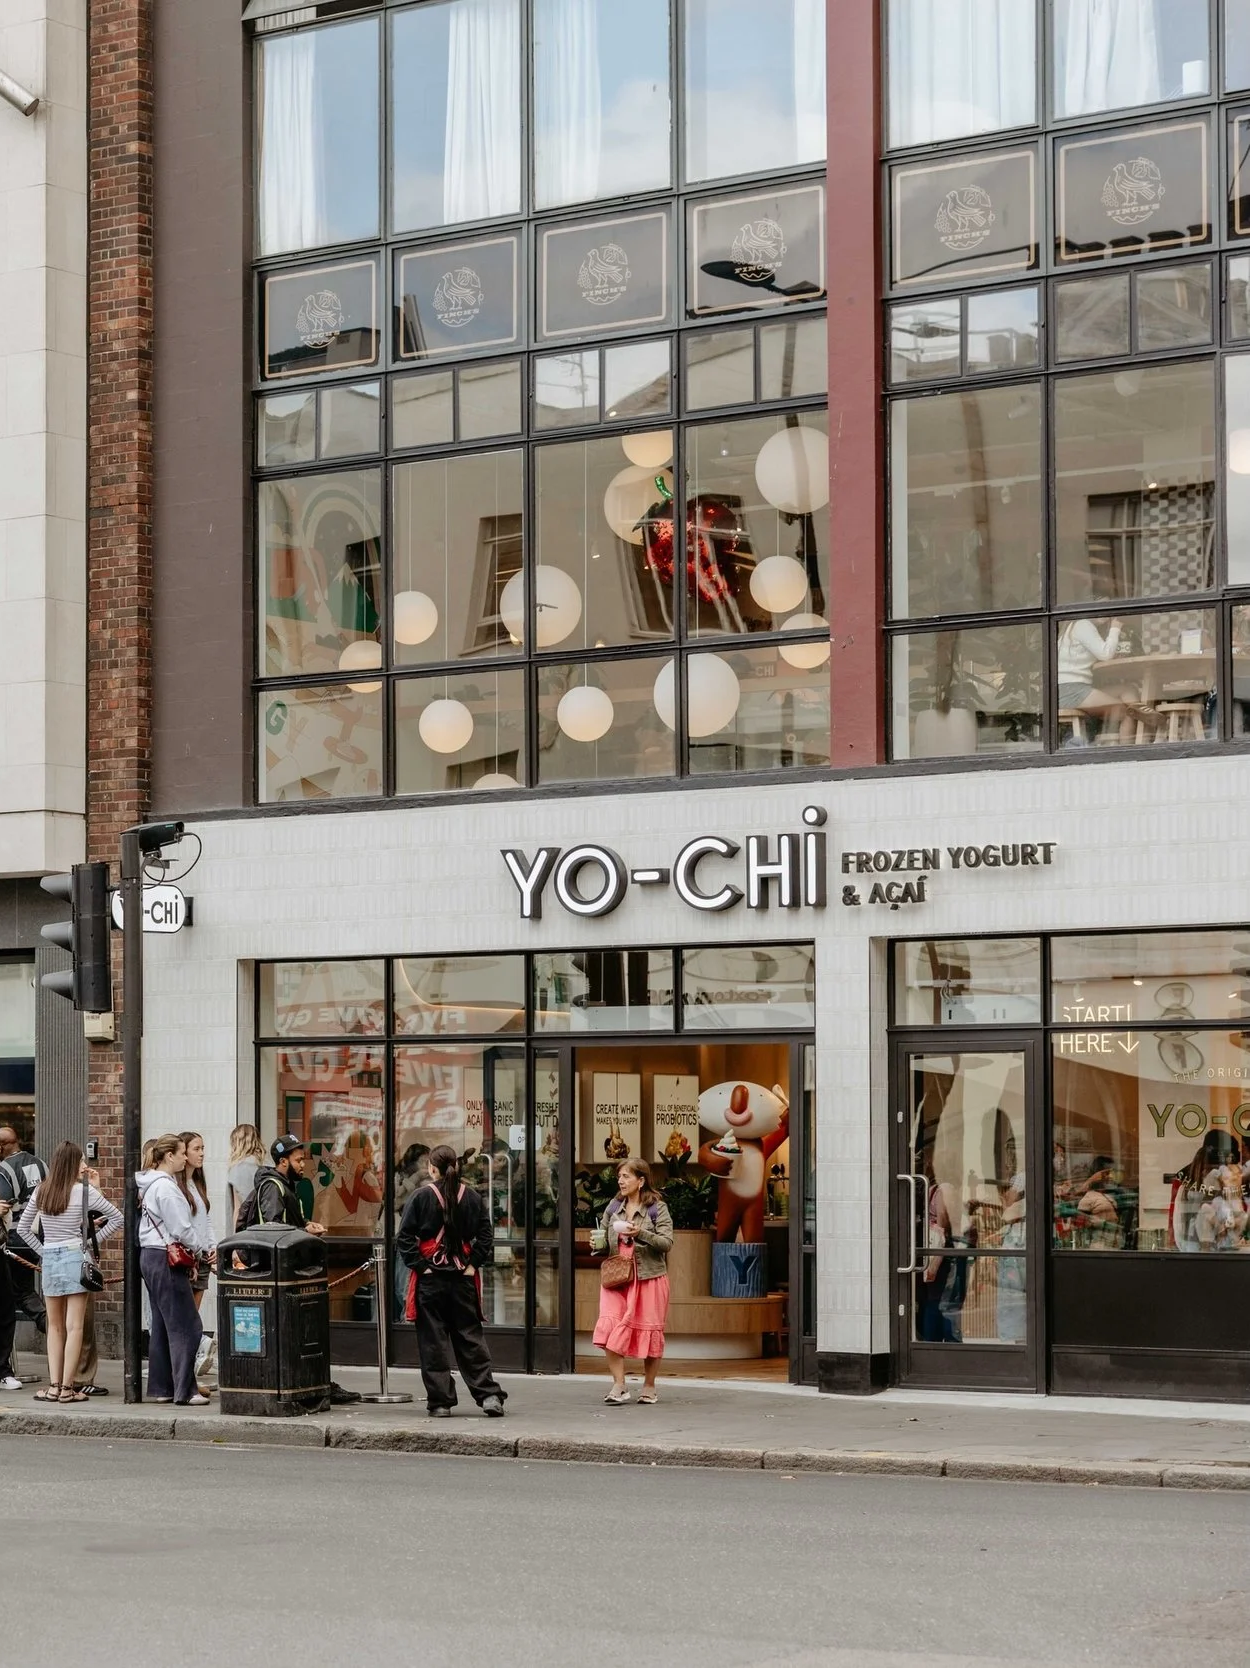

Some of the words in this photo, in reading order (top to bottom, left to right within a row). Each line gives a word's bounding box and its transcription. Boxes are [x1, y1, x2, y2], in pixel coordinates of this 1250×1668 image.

[1106, 203, 1160, 216] FINCH'S
[940, 229, 990, 242] FINCH'S
[734, 261, 783, 274] FINCH'S
[582, 285, 627, 298] FINCH'S
[436, 308, 480, 320] FINCH'S
[841, 848, 940, 874] FROZEN
[947, 842, 1057, 869] YOGURT
[842, 885, 861, 906] &
[868, 875, 928, 910] AÇAÍ
[1060, 1033, 1113, 1053] HERE
[1173, 1070, 1199, 1083] THE
[466, 1100, 483, 1111] ONLY
[494, 1101, 513, 1112] GANIC
[535, 1102, 553, 1112] RESH
[596, 1104, 619, 1114] CREATE
[620, 1104, 638, 1114] WHAT
[657, 1104, 667, 1112] FULL
[667, 1104, 673, 1112] OF
[674, 1104, 697, 1112] BENEFICIAL
[494, 1114, 513, 1127] RRIES
[613, 1117, 622, 1125] YOU
[623, 1117, 638, 1125] HAPPY
[656, 1113, 697, 1125] PROBIOTICS
[1177, 1171, 1215, 1196] SHARE
[729, 1255, 758, 1286] Y
[233, 1287, 265, 1295] LITTER
